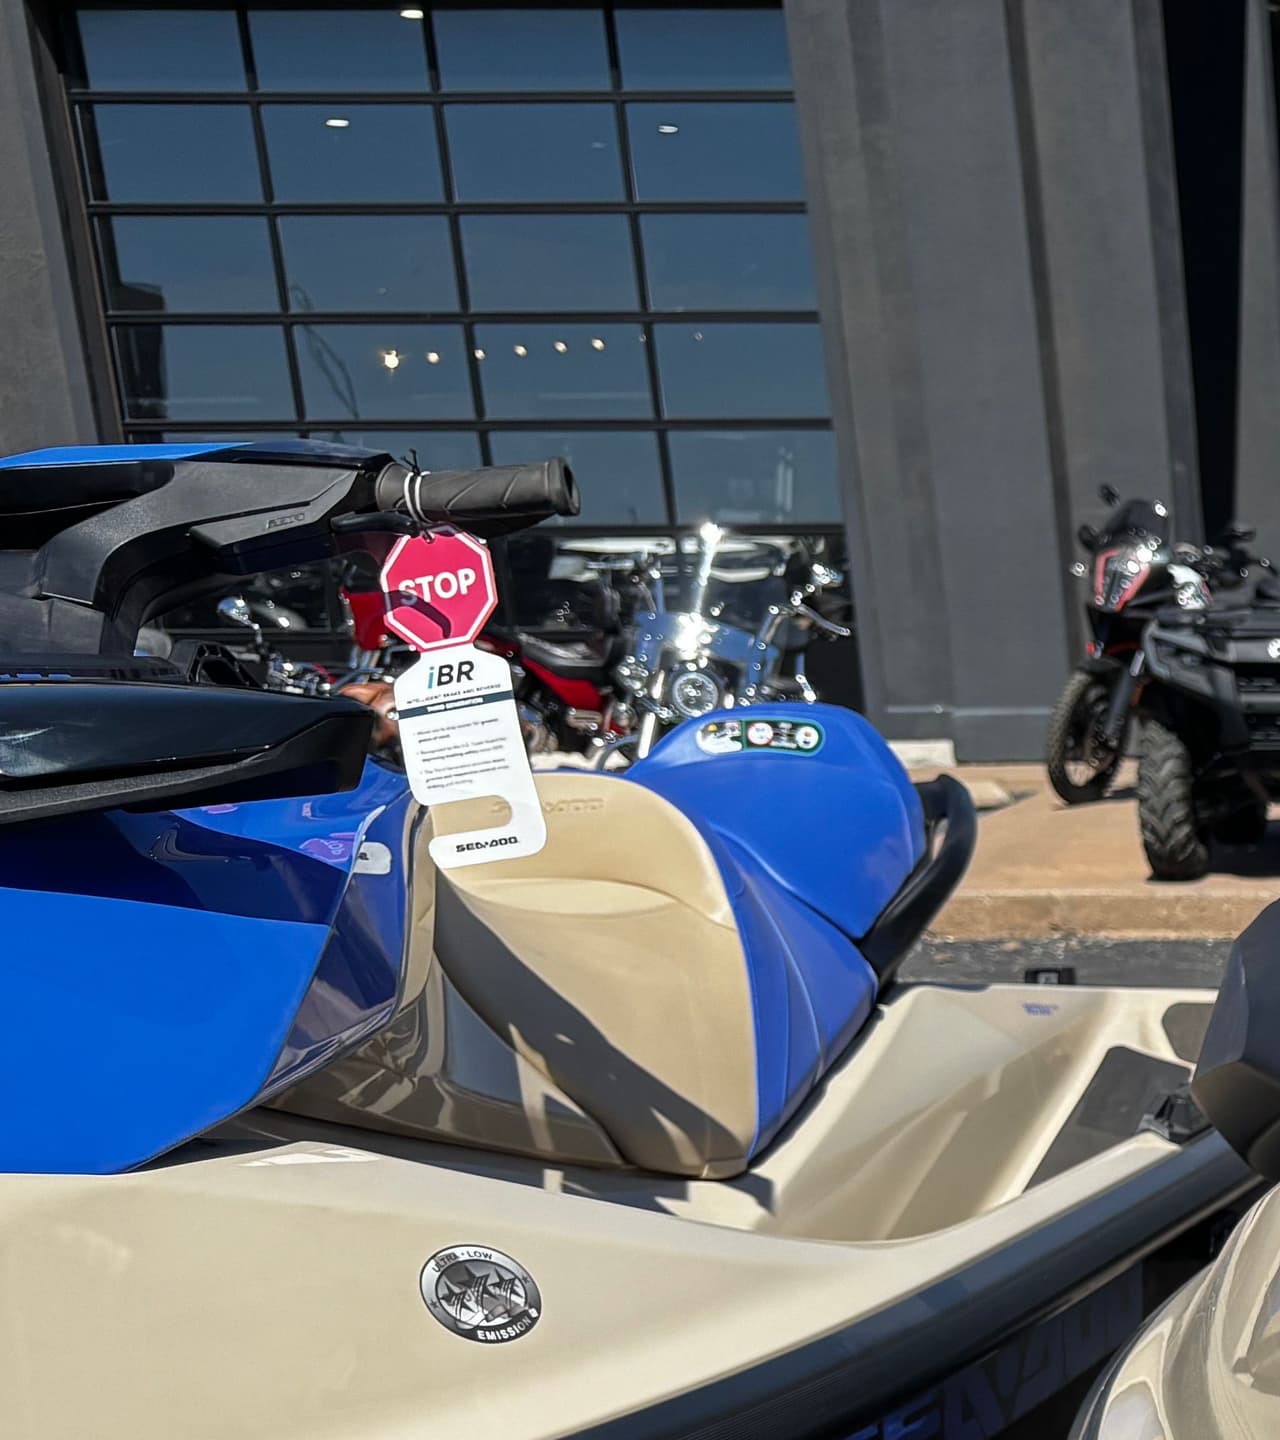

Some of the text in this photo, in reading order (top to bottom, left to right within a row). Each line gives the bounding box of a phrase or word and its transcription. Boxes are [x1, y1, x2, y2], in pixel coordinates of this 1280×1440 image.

[398, 568, 477, 606] STOP
[427, 660, 475, 690] iBR
[466, 1250, 493, 1260] LOW
[476, 1315, 532, 1341] EMISSION
